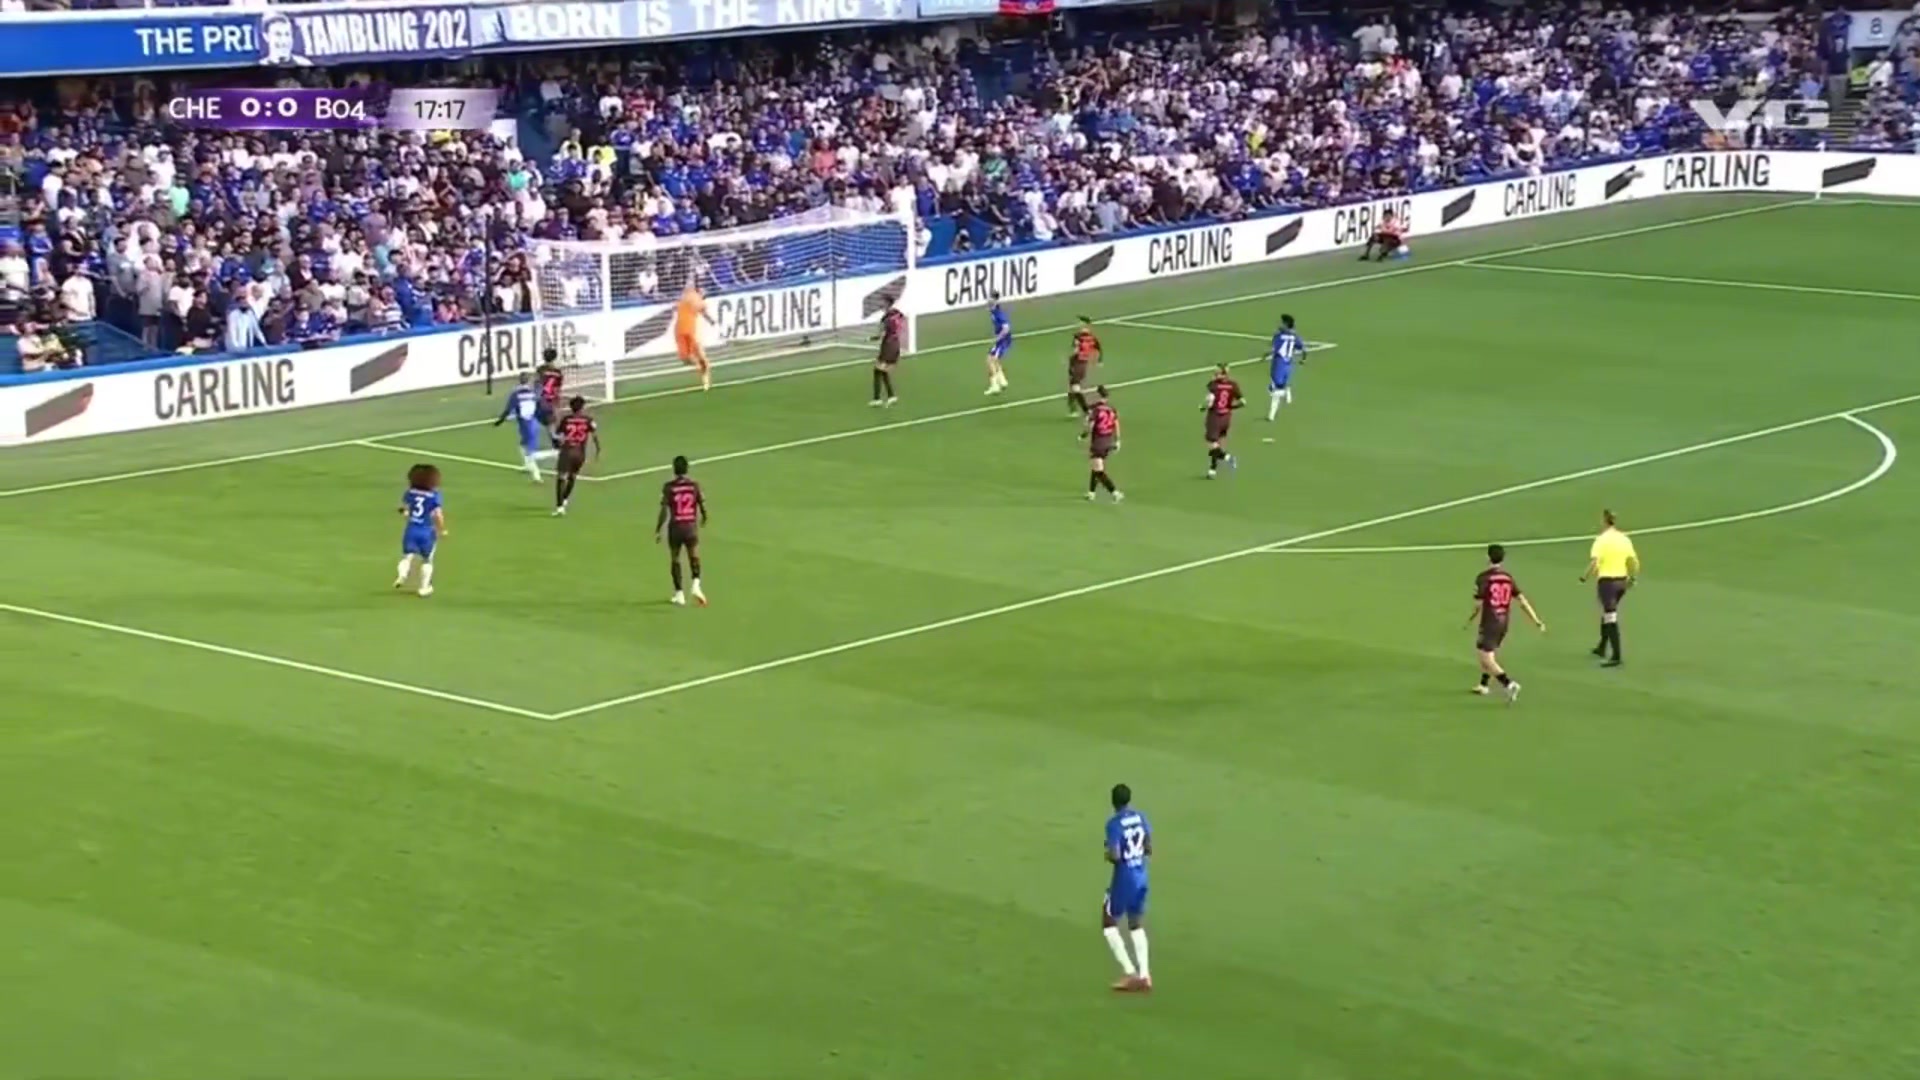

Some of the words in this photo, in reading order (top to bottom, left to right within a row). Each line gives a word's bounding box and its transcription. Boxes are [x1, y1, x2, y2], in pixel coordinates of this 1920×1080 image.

[295, 10, 419, 56] TAMBLING
[423, 9, 469, 49] 202
[510, 3, 622, 37] BORN
[637, 0, 672, 36] IS
[689, 0, 762, 31] THE
[134, 27, 195, 56] THE
[1664, 154, 1770, 191] CARLING
[1504, 173, 1576, 217] CARLING
[1149, 227, 1232, 274] CARLING
[945, 256, 1038, 306] CARLING
[717, 287, 821, 339] CARLING
[154, 358, 295, 420] CARLING
[412, 496, 425, 517] 3
[674, 493, 695, 514] 12
[1489, 582, 1512, 606] 30
[1124, 826, 1145, 859] 32
